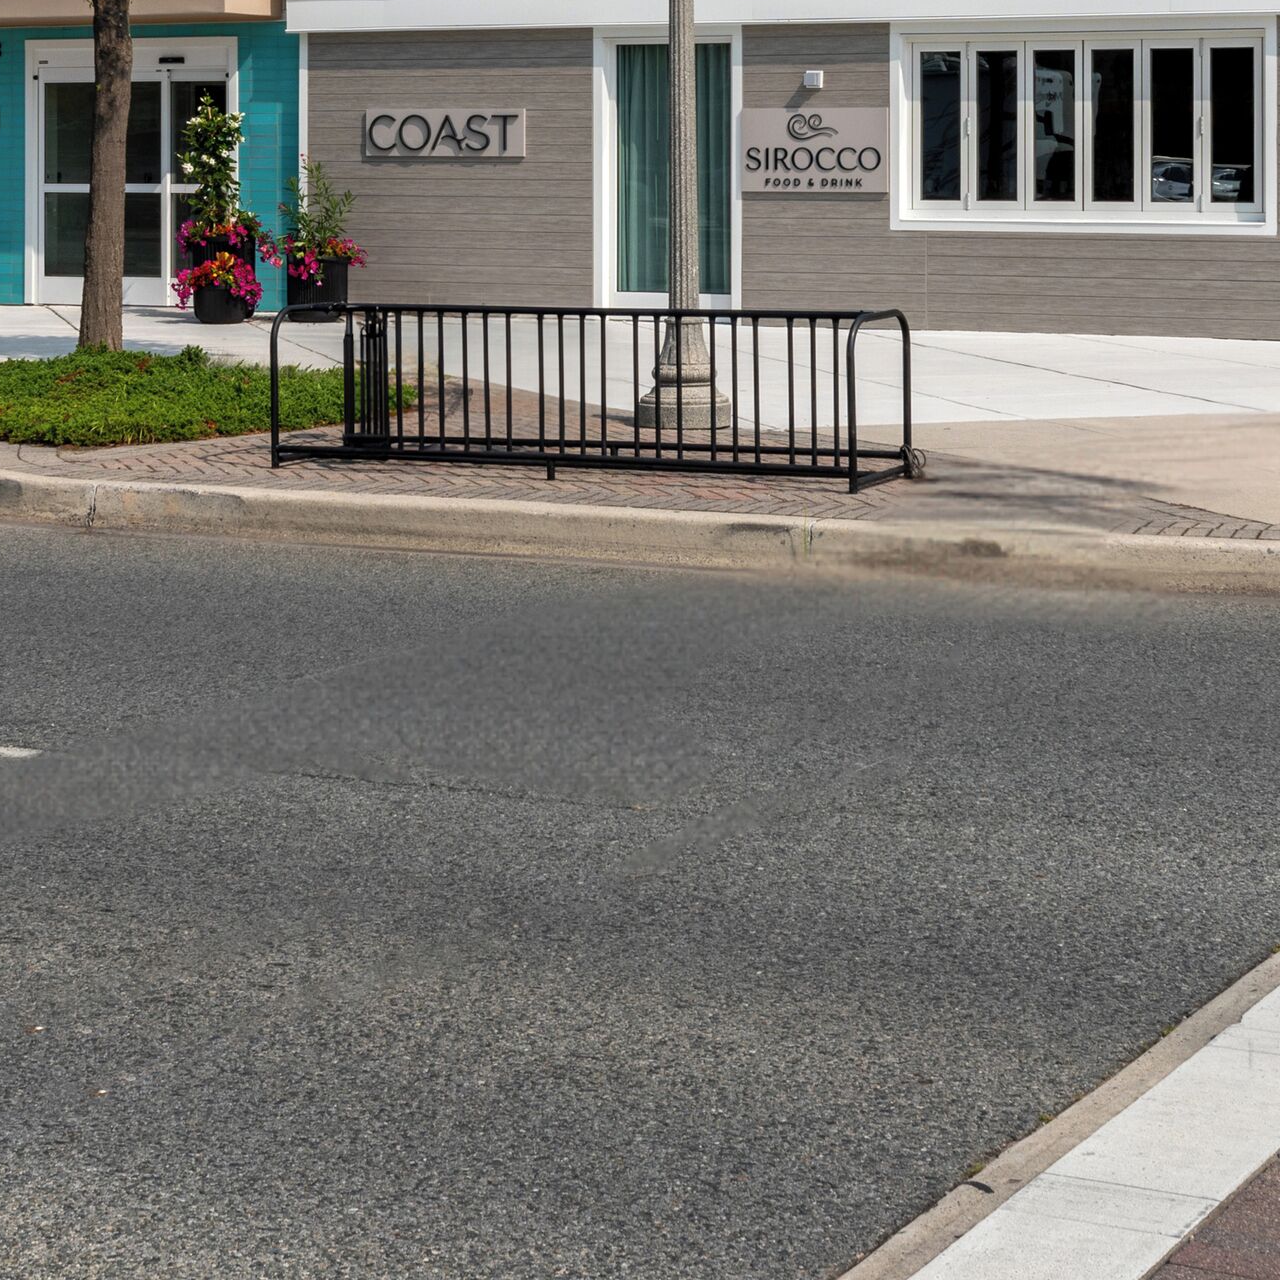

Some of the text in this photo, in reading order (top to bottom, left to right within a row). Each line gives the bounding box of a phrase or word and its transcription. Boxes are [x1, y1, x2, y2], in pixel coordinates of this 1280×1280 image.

[368, 114, 520, 151] COAST
[745, 146, 882, 171] SIROCCO
[764, 177, 863, 187] FOOD & DRINK
